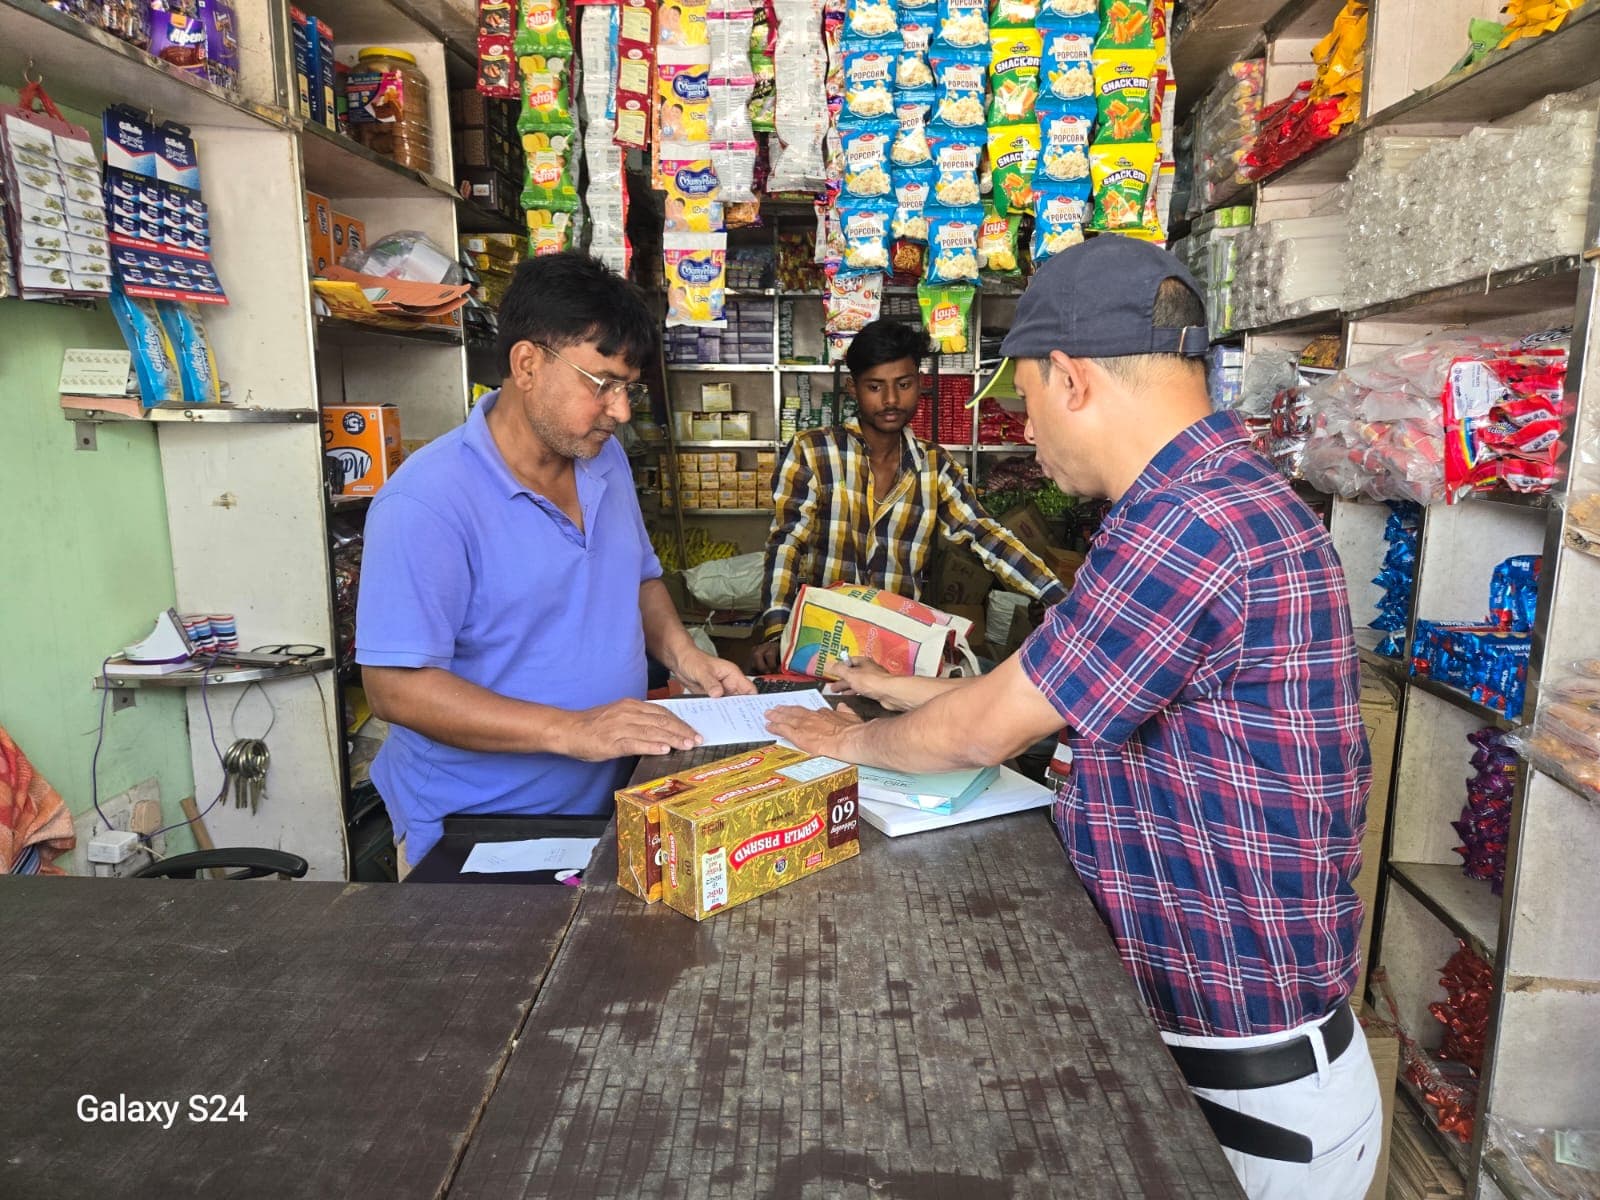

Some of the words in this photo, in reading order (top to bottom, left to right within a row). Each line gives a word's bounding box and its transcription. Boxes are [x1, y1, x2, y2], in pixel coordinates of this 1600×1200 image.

[903, 42, 925, 50] PCORN
[1057, 50, 1088, 59] POPCORN
[853, 69, 885, 80] POPCORN
[948, 80, 979, 89] POPCORN
[1053, 134, 1085, 144] POPCORN
[942, 161, 974, 169] POPCORN
[900, 201, 923, 209] POPCOR
[1050, 213, 1082, 223] POPCORN
[849, 226, 881, 236] POPCORN
[942, 239, 973, 248] POPCORN
[831, 799, 856, 824] 60
[829, 818, 858, 835] Celebrating
[784, 820, 820, 845] KAMLA
[734, 836, 781, 863] PASAND
